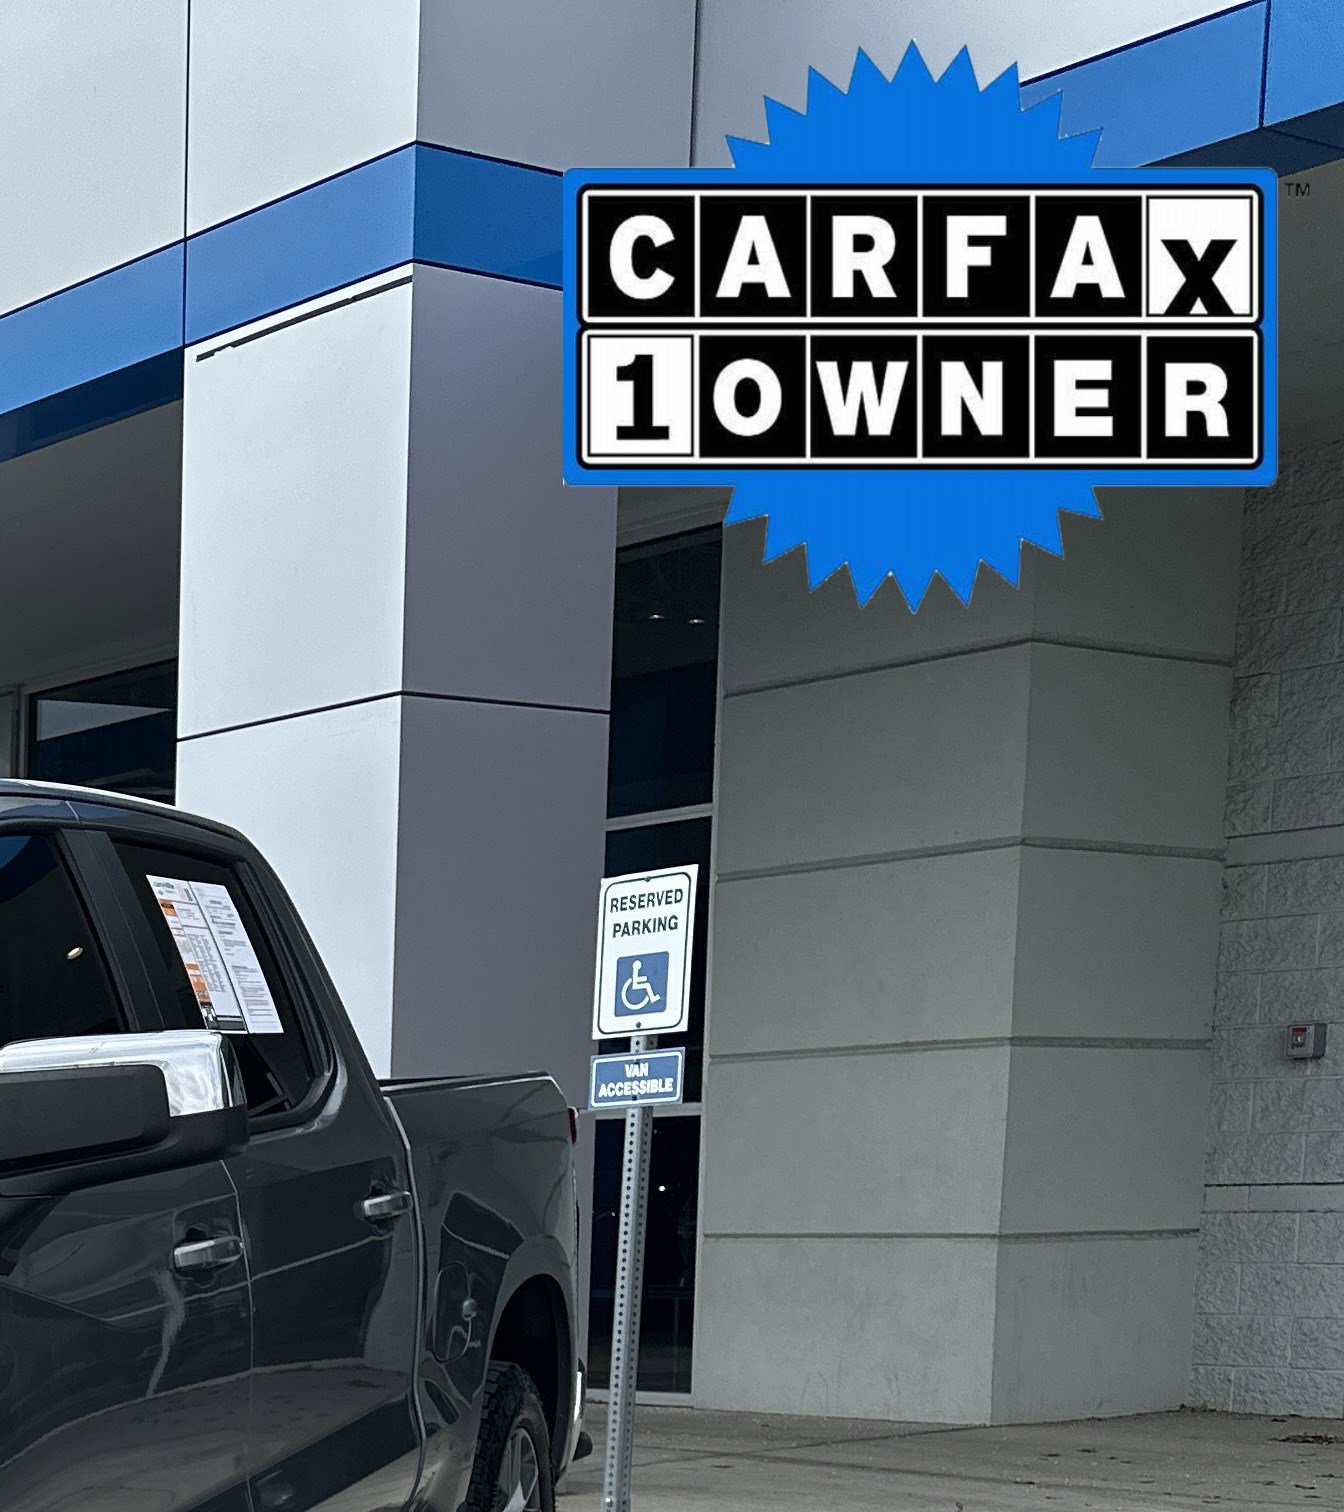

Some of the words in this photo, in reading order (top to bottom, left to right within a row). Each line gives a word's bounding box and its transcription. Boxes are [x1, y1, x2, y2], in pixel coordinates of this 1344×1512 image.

[610, 888, 683, 912] RESERVED
[612, 915, 678, 938] PARKING
[624, 1063, 649, 1078] VAN
[598, 1078, 674, 1098] ACCESSIBLE
